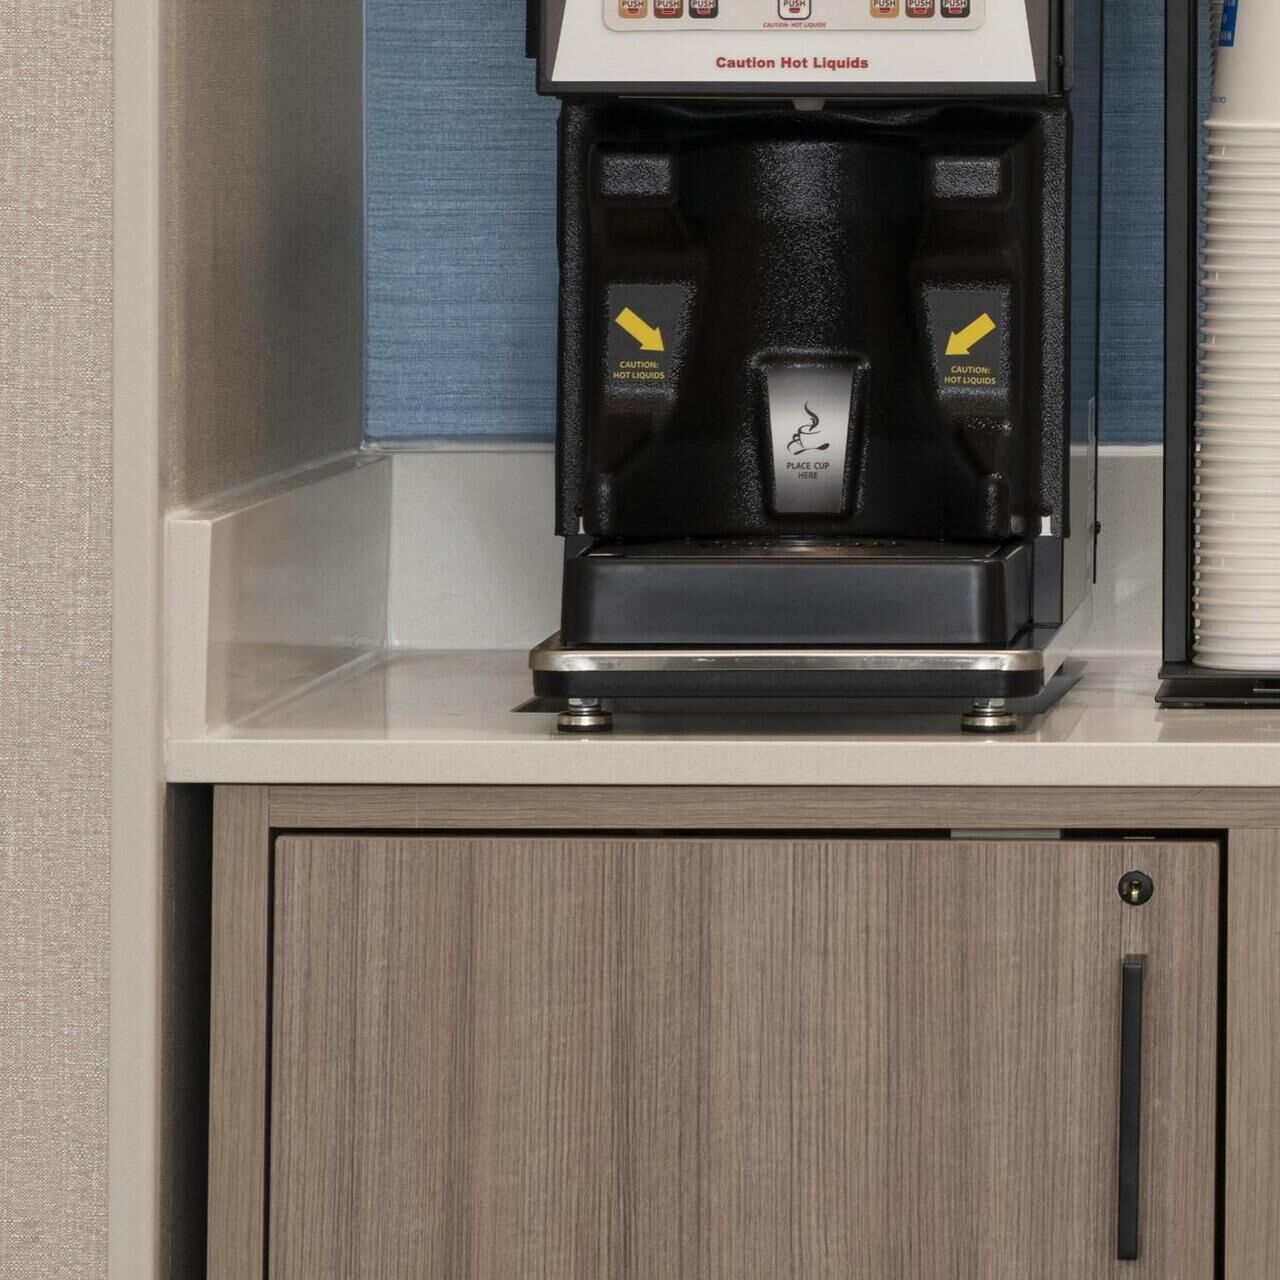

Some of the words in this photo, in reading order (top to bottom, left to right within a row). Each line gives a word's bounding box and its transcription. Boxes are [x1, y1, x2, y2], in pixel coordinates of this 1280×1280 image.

[622, 0, 644, 7] PUSH
[657, 0, 680, 7] PUSH
[692, 0, 715, 7] PUSH
[783, 0, 806, 7] PUSH
[873, 0, 896, 7] PUSH
[909, 0, 931, 7] PUSH
[944, 0, 967, 7] PUSH
[715, 56, 776, 69] Caution
[780, 56, 808, 69] Hot
[813, 56, 869, 71] Liquids
[619, 360, 660, 369] CAUTION:
[951, 365, 992, 374] CAUTION:
[613, 371, 631, 379] HOT
[631, 371, 665, 380] LIQUIDS
[943, 376, 961, 384] HOT
[963, 376, 996, 385] LIQUIDS
[786, 461, 811, 470] PLACE
[814, 461, 830, 470] CUP
[798, 471, 818, 480] HERE
